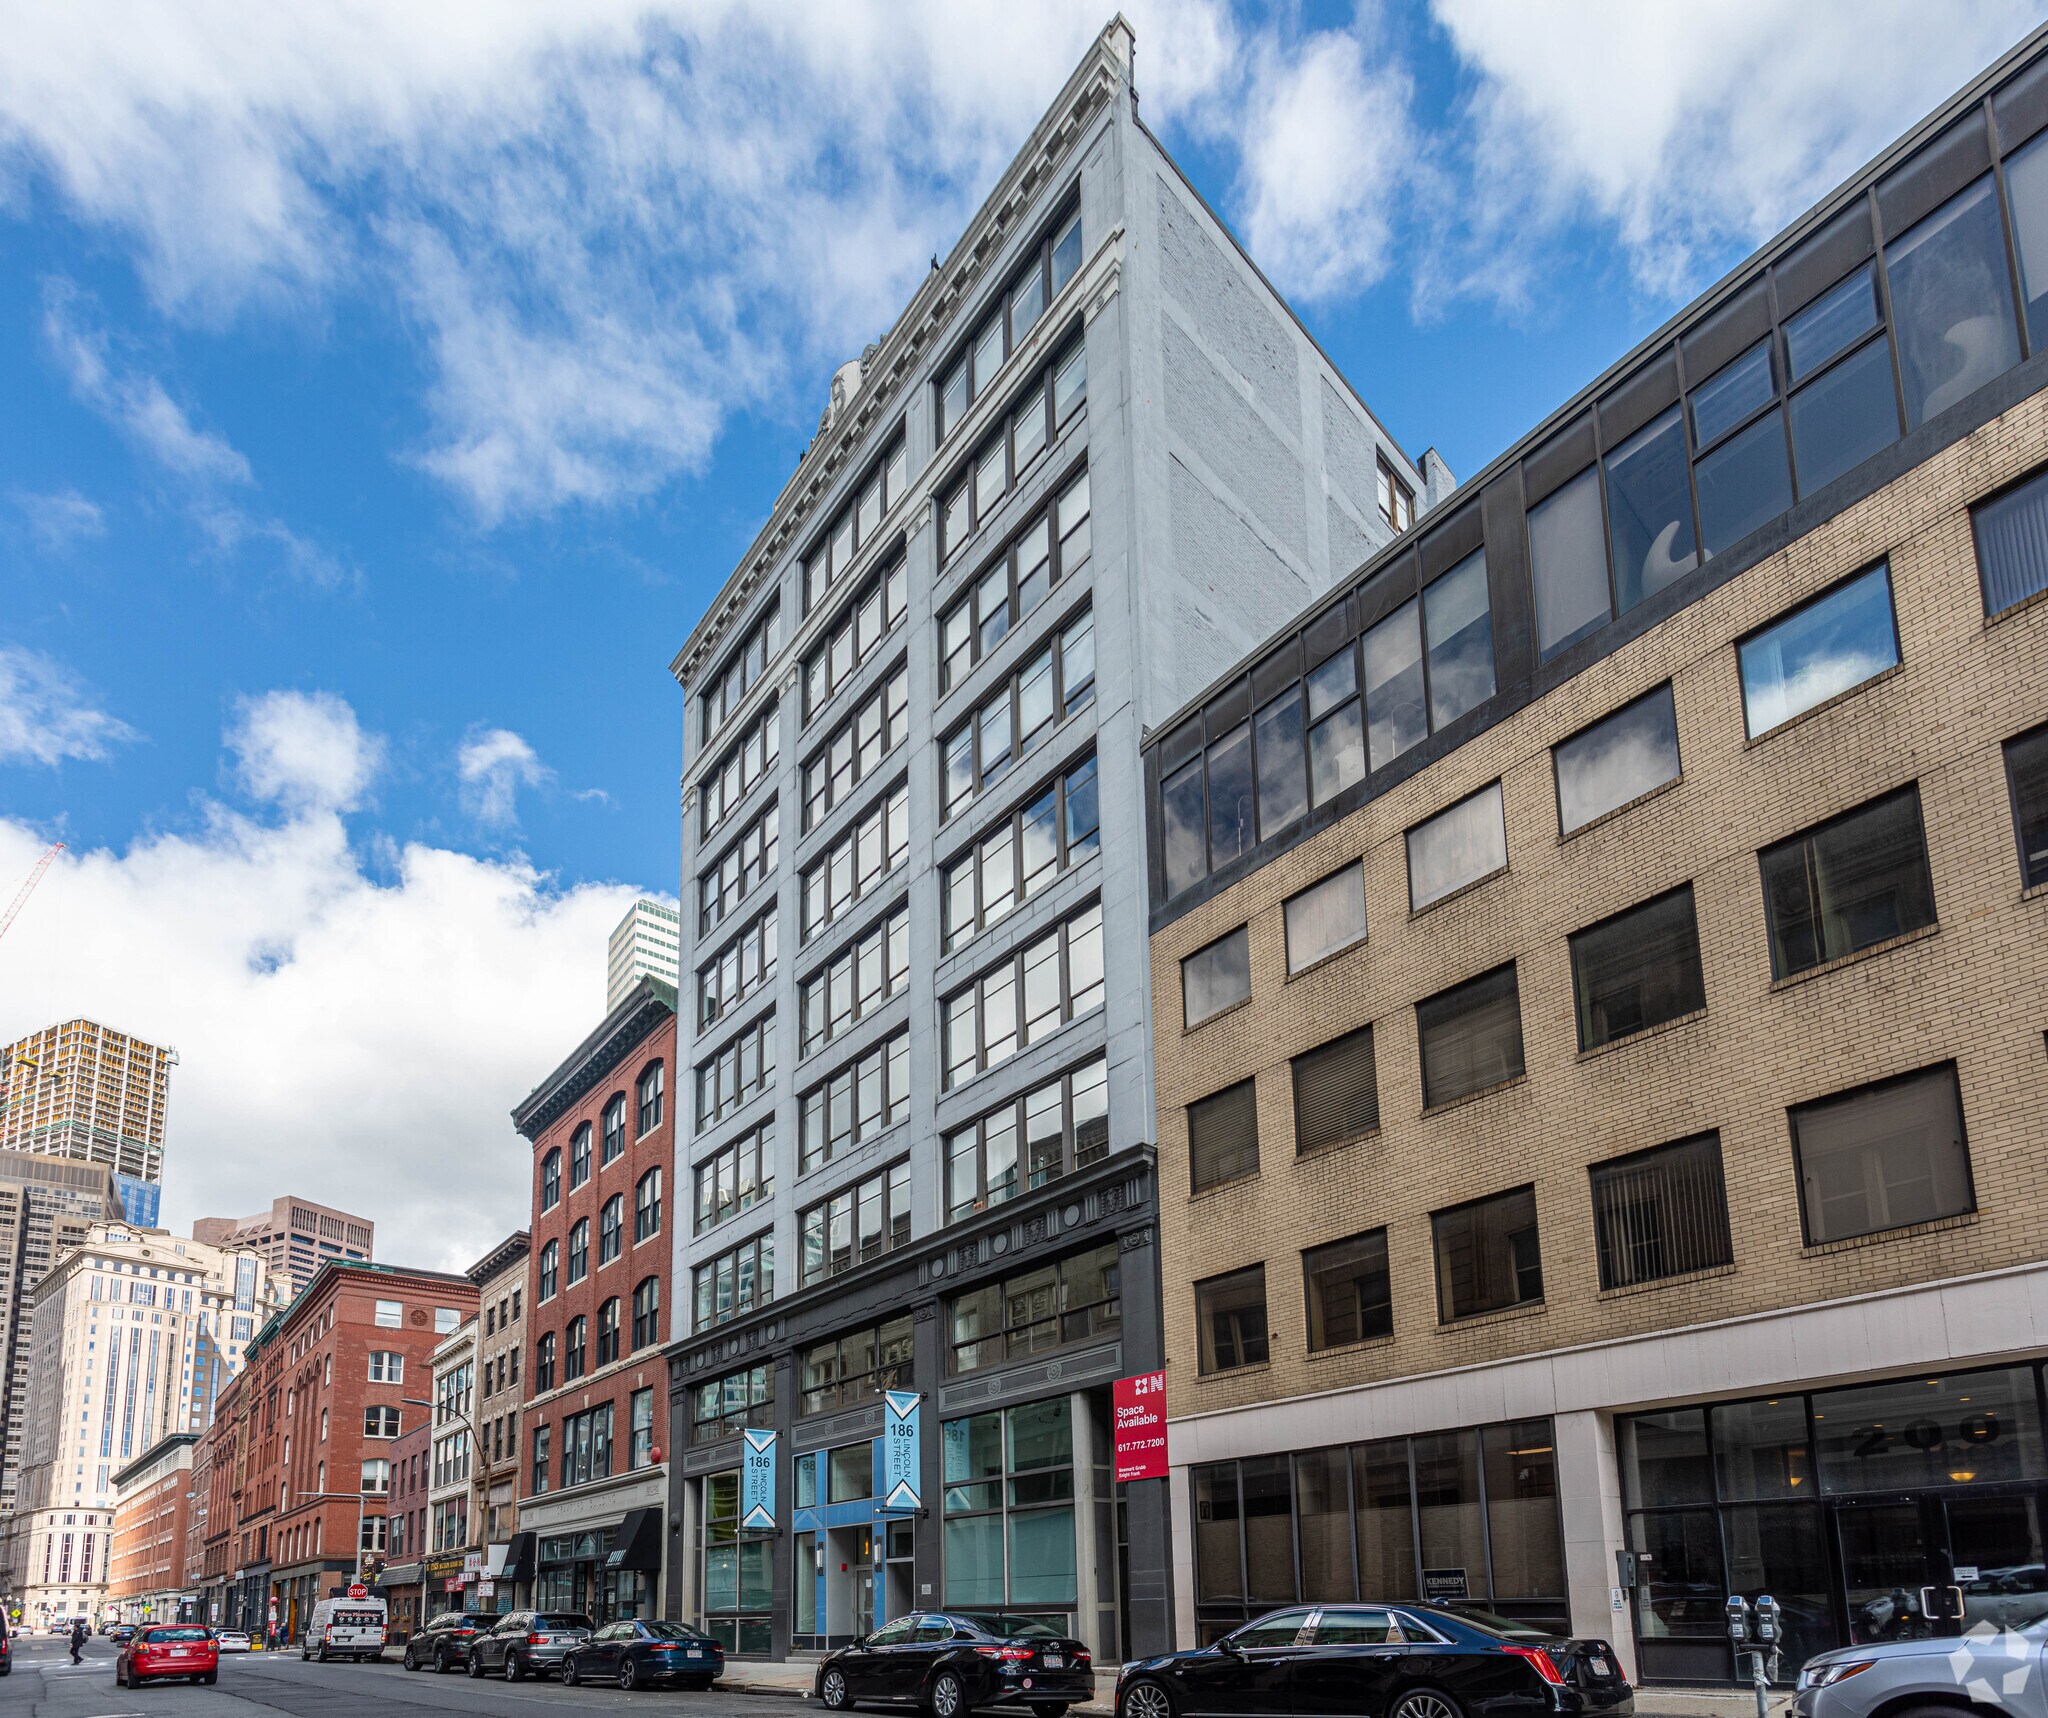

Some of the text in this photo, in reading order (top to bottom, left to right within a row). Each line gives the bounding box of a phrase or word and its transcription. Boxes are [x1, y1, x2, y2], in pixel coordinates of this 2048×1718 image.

[1117, 1405, 1144, 1419] Space
[1117, 1413, 1158, 1430] Available
[890, 1423, 914, 1437] 186
[1850, 1413, 2000, 1457] 200
[1118, 1437, 1165, 1452] 617.772.7200
[749, 1456, 770, 1468] 186
[893, 1438, 901, 1477] STREET
[903, 1438, 911, 1478] LINCOLN
[750, 1468, 758, 1501] STREET
[1426, 1576, 1464, 1585] KENNEDY
[349, 1588, 367, 1596] STOP
